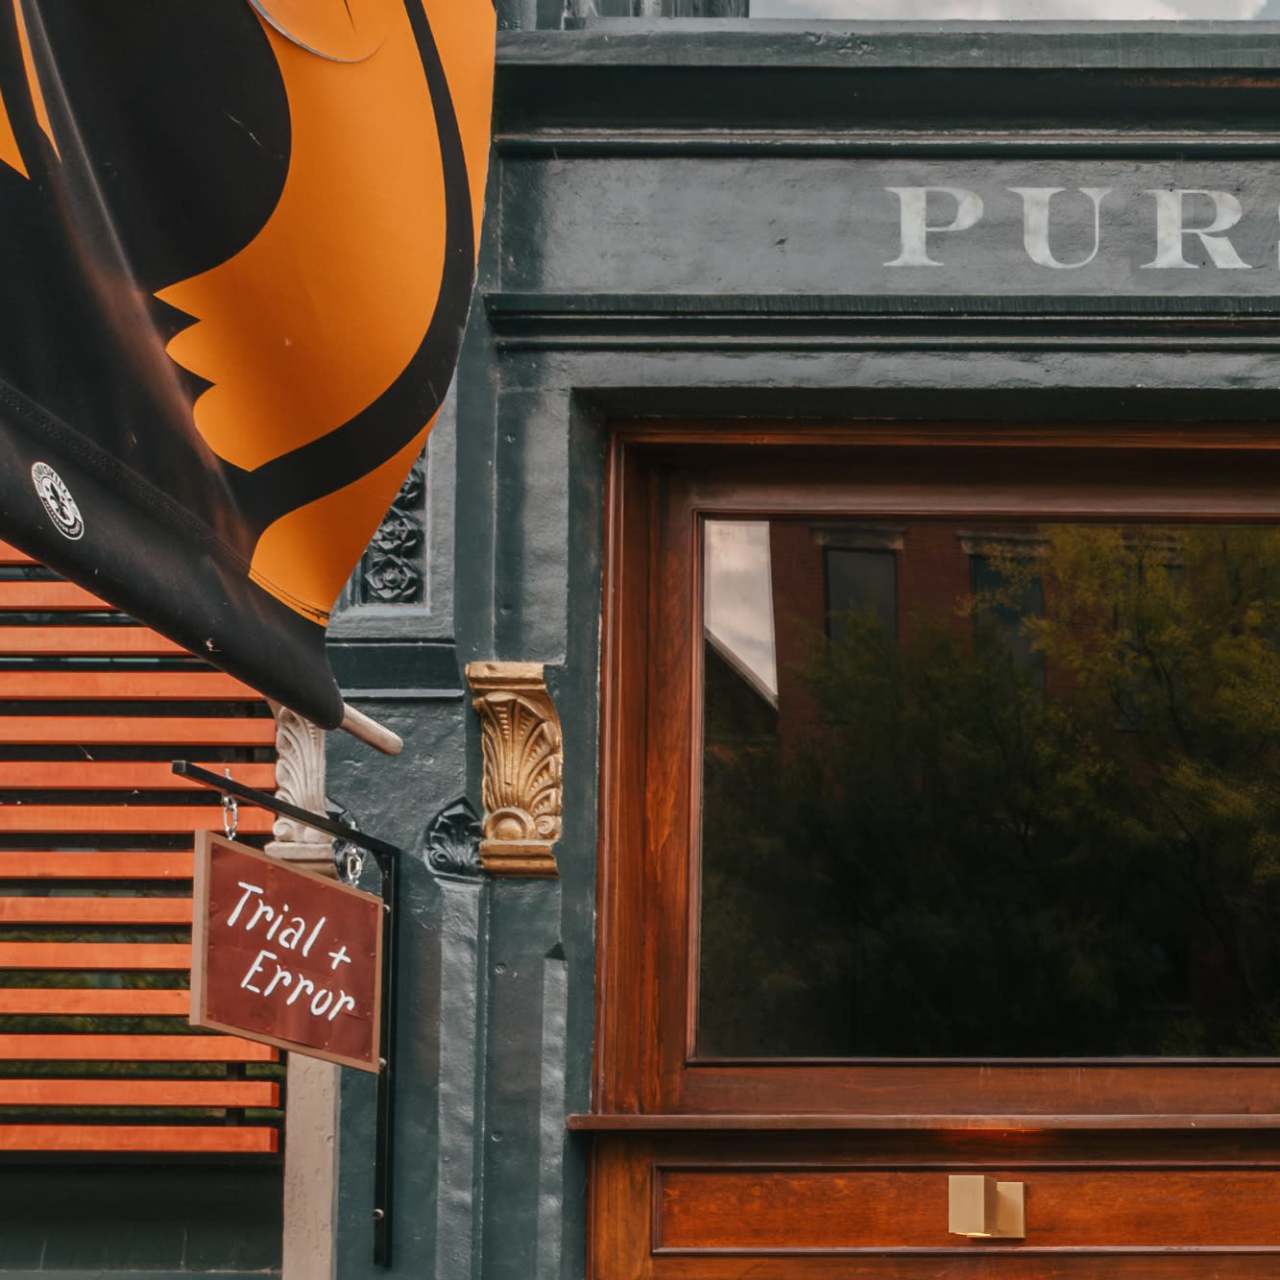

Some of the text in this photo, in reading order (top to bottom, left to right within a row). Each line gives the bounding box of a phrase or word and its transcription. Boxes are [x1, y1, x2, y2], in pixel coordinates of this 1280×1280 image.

[227, 881, 352, 970] Trial +
[239, 949, 355, 1021] Error
